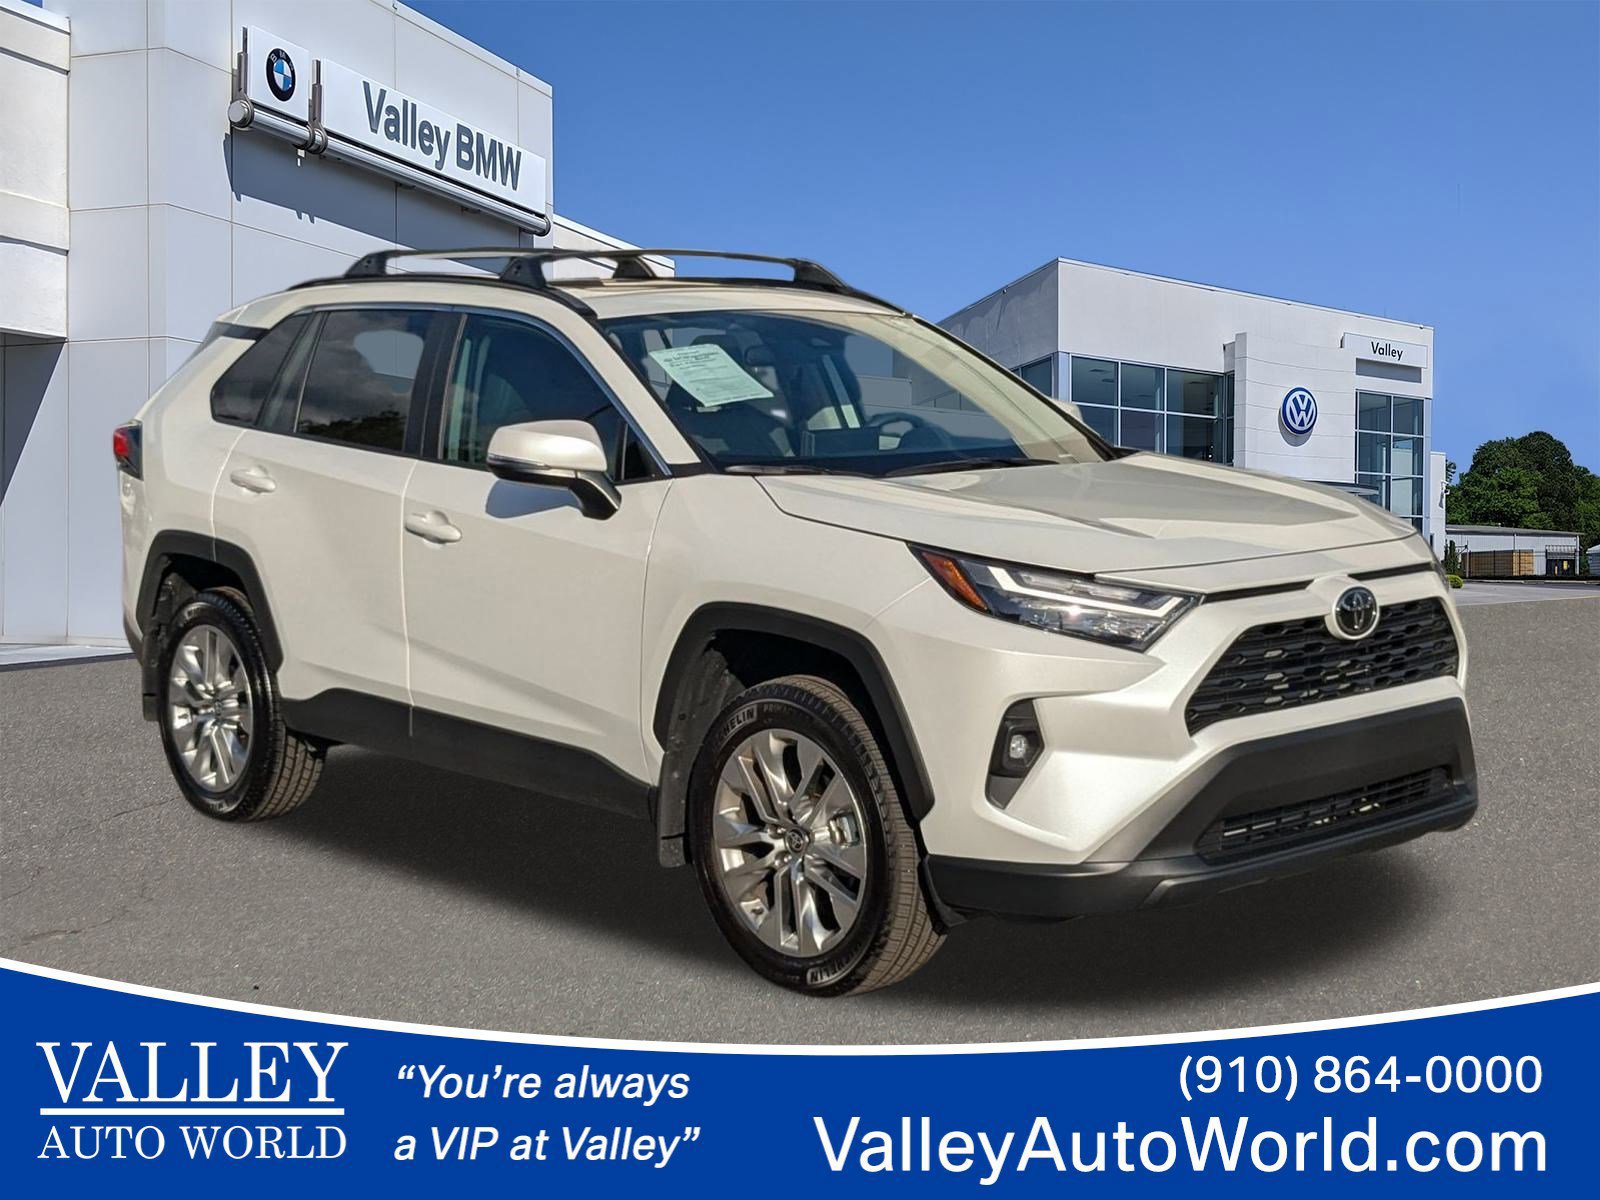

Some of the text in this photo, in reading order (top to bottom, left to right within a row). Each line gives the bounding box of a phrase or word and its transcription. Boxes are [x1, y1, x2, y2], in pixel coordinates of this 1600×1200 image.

[362, 80, 522, 191] Valley BMW
[1370, 341, 1404, 361] Valley
